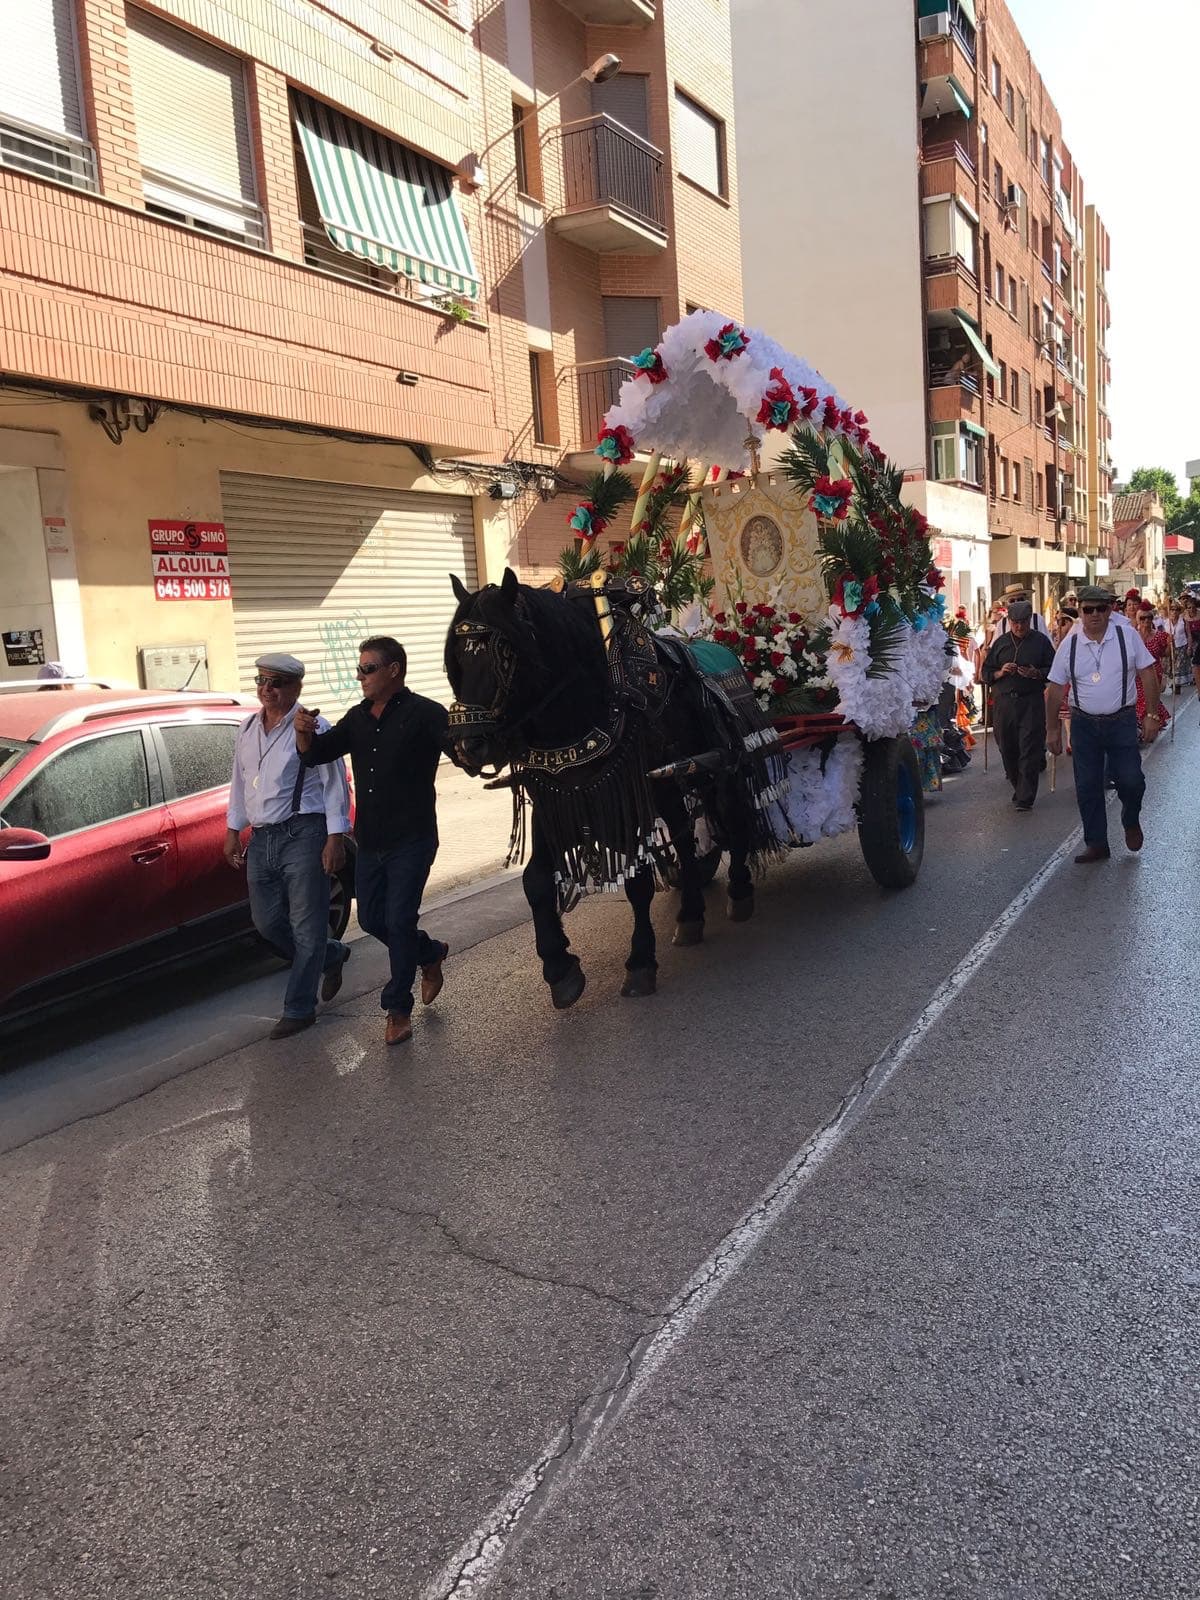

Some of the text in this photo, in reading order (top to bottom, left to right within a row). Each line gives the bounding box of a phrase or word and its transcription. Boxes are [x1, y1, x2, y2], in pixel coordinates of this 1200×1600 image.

[151, 529, 185, 542] GRUPO
[200, 529, 225, 543] SIMÓ
[157, 557, 226, 573] ALQUILA
[157, 579, 230, 598] 645 500 578
